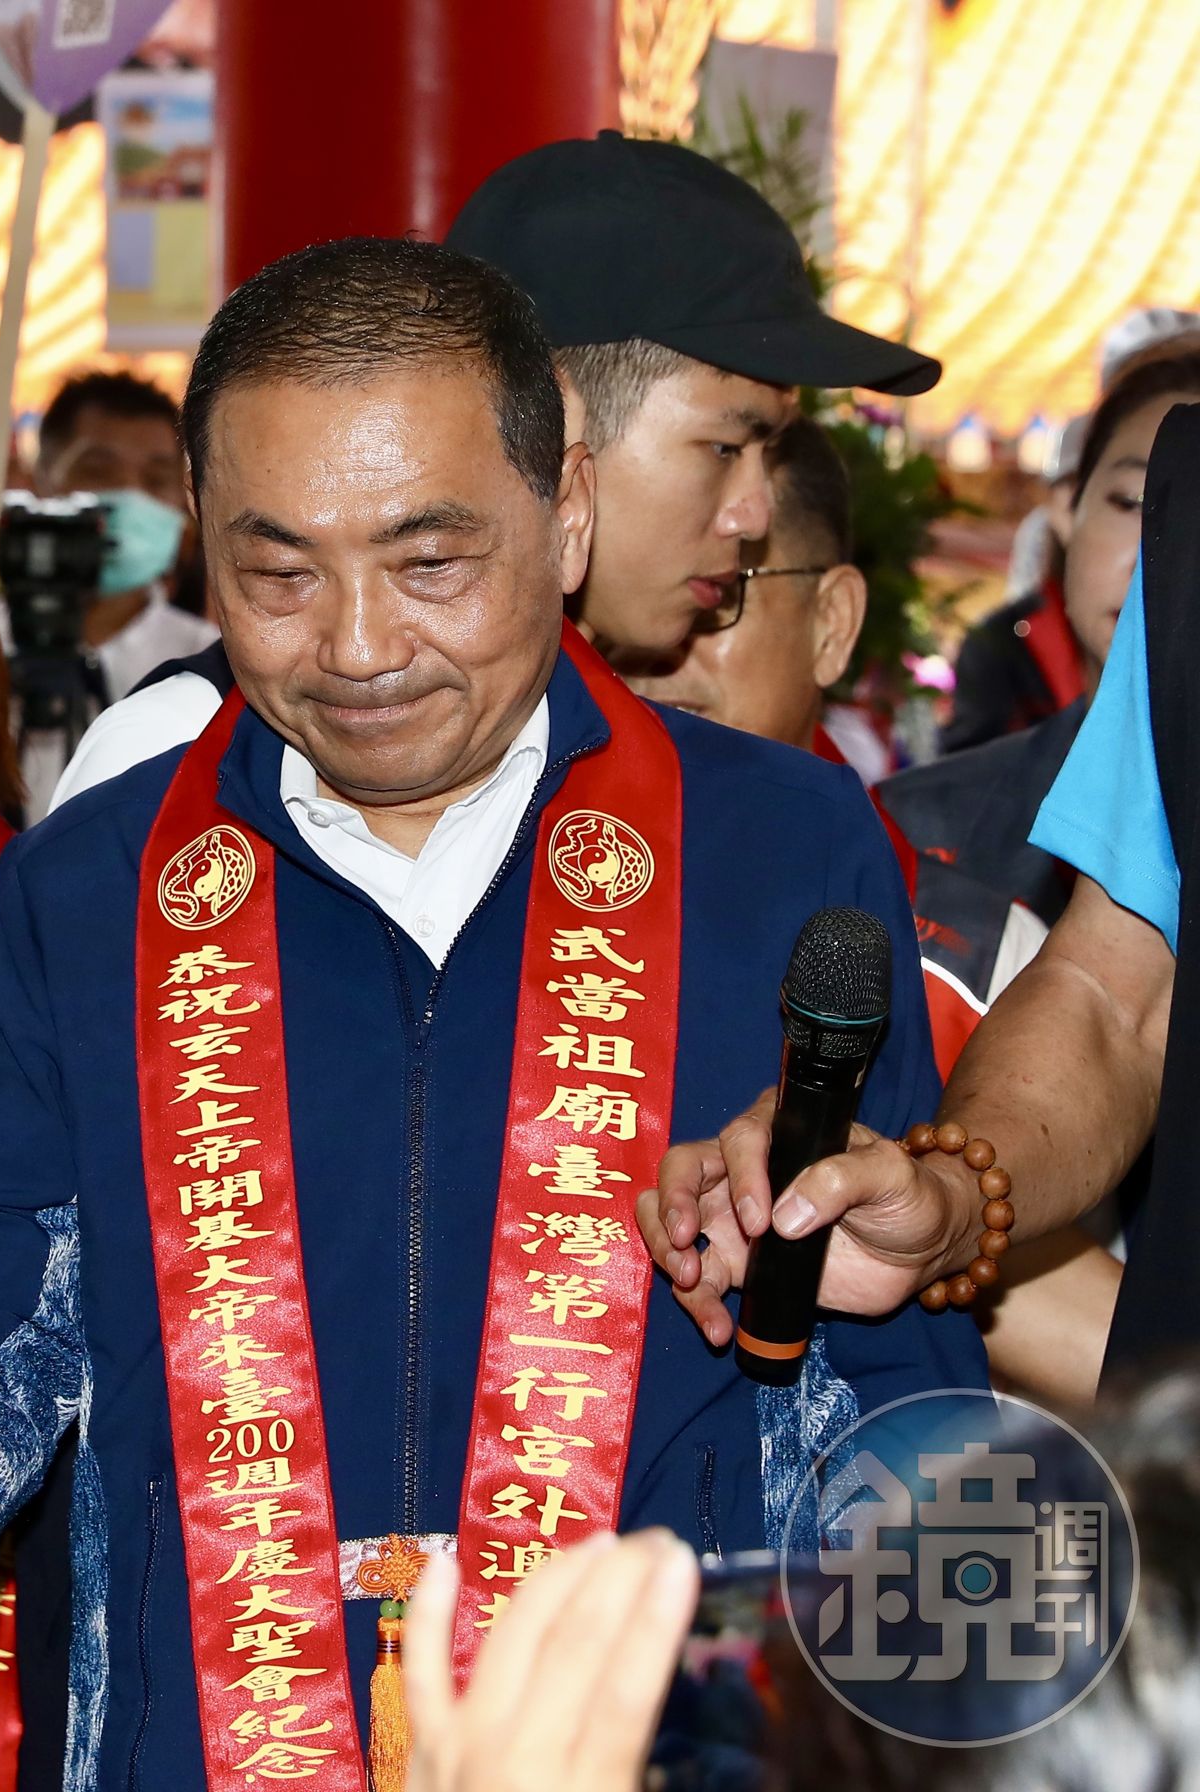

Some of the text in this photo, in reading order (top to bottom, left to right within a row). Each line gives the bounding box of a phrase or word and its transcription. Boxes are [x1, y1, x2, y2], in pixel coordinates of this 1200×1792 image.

[157, 945, 338, 1783] 恭祝玄天上帝開基大帝來臺200週年慶大聖會紀念
